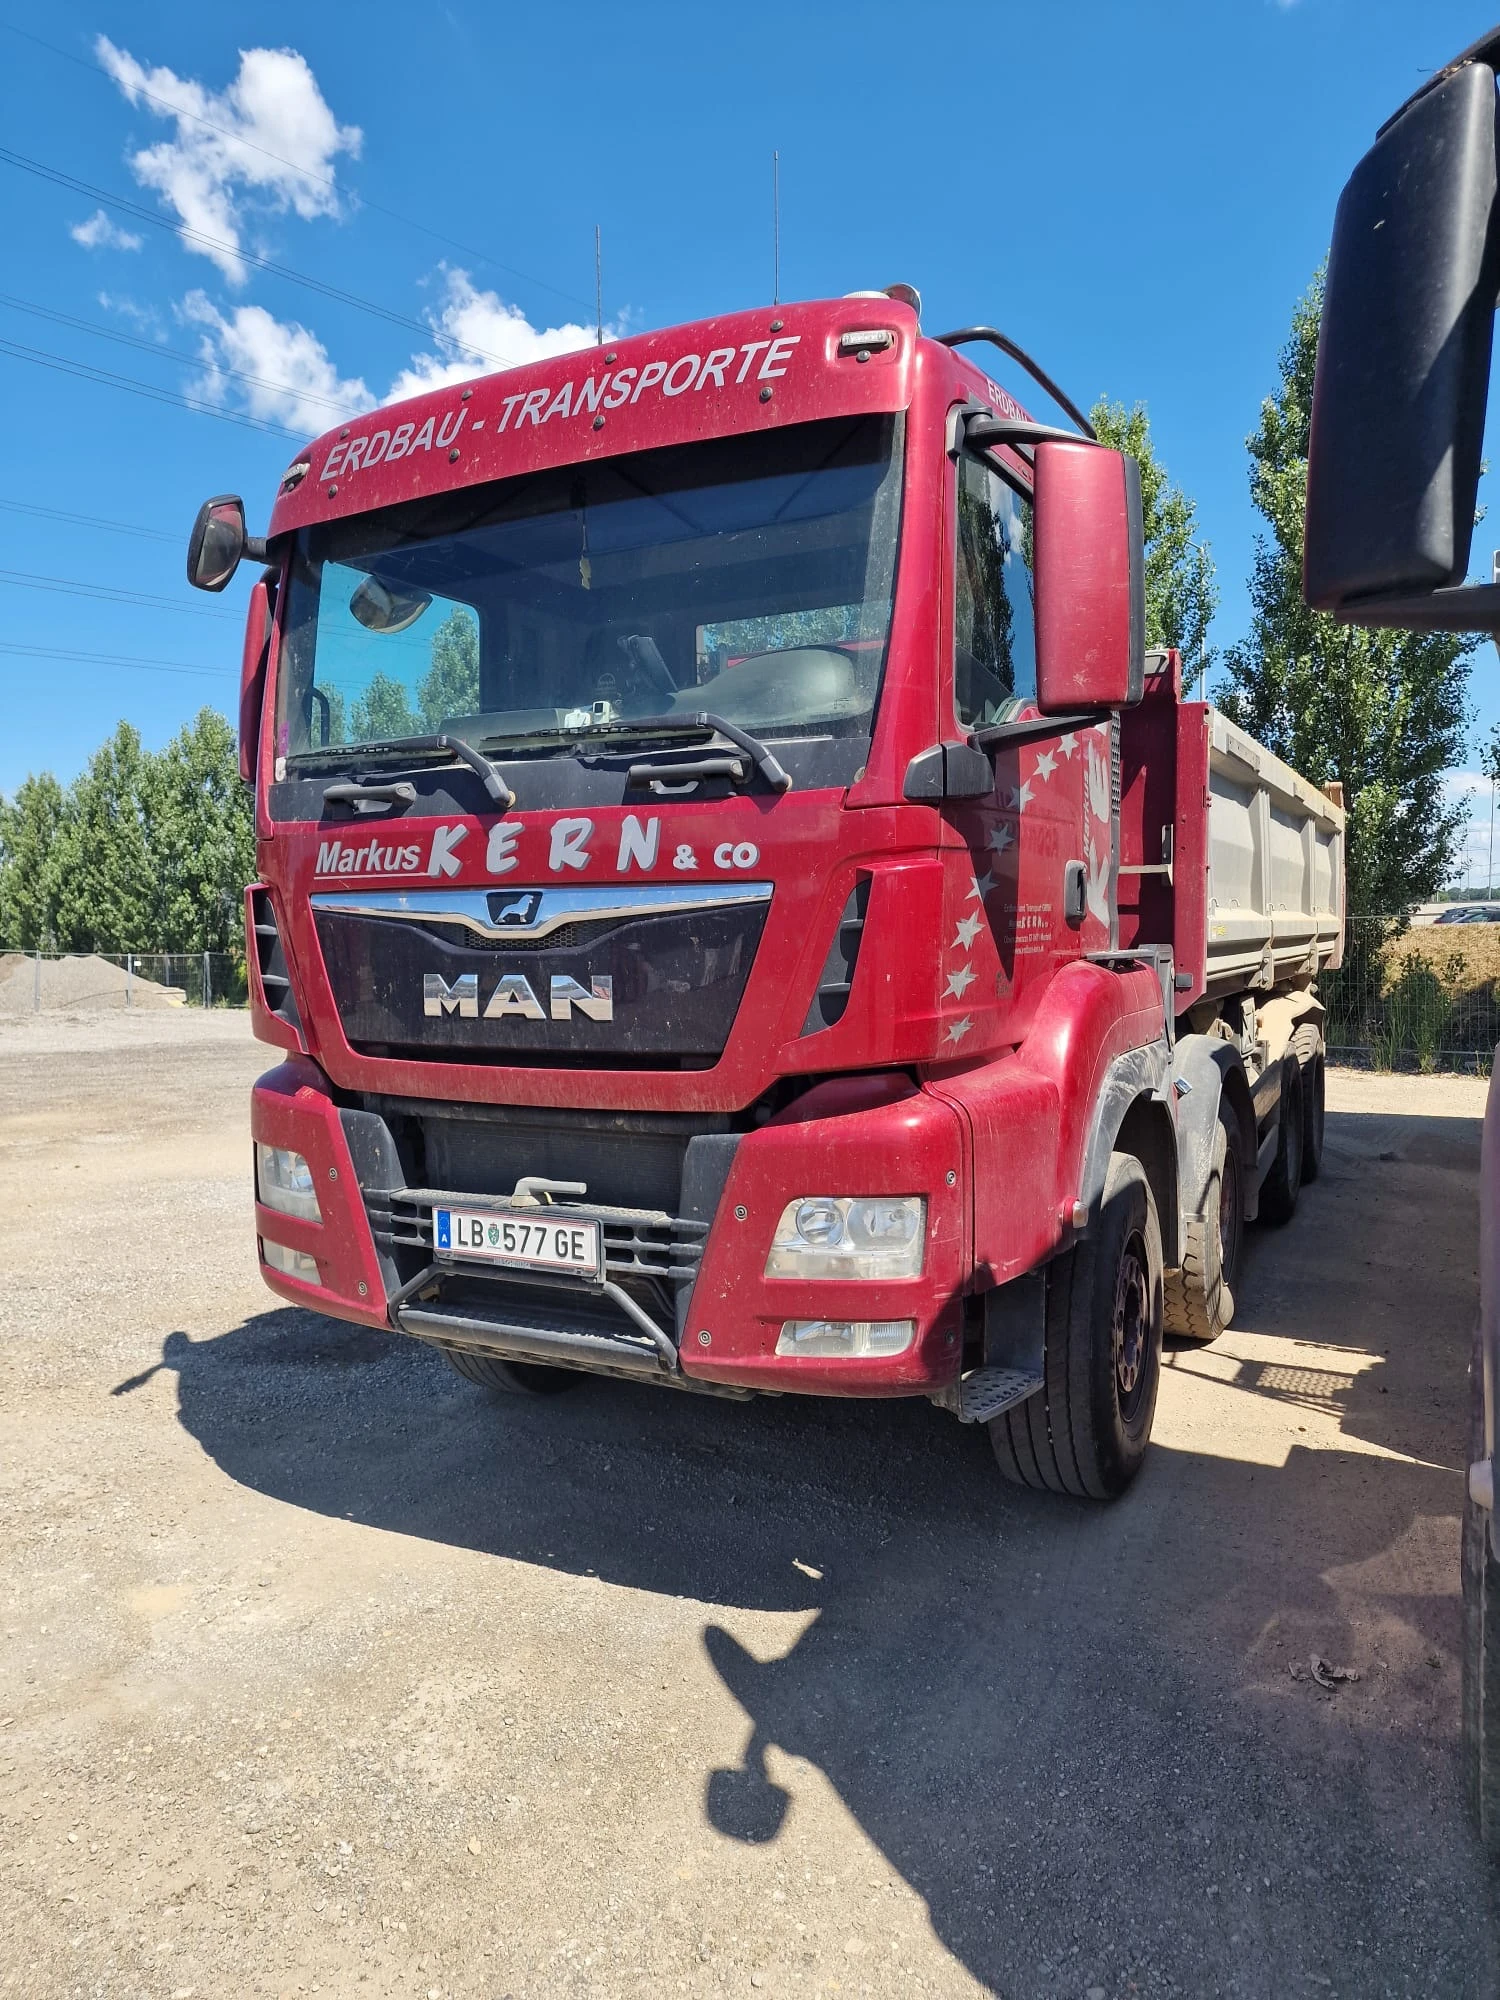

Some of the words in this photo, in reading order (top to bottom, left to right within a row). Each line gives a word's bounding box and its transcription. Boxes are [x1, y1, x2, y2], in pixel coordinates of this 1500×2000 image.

[319, 408, 468, 482] ERDBAU
[497, 335, 801, 433] TRANSPORTE
[315, 839, 421, 875] Markus
[427, 813, 662, 878] KERN
[672, 844, 699, 870] &
[422, 973, 614, 1021] MAN
[441, 1233, 448, 1243] A
[457, 1216, 484, 1248] LB
[503, 1223, 548, 1256] 577
[555, 1229, 586, 1260] GE
